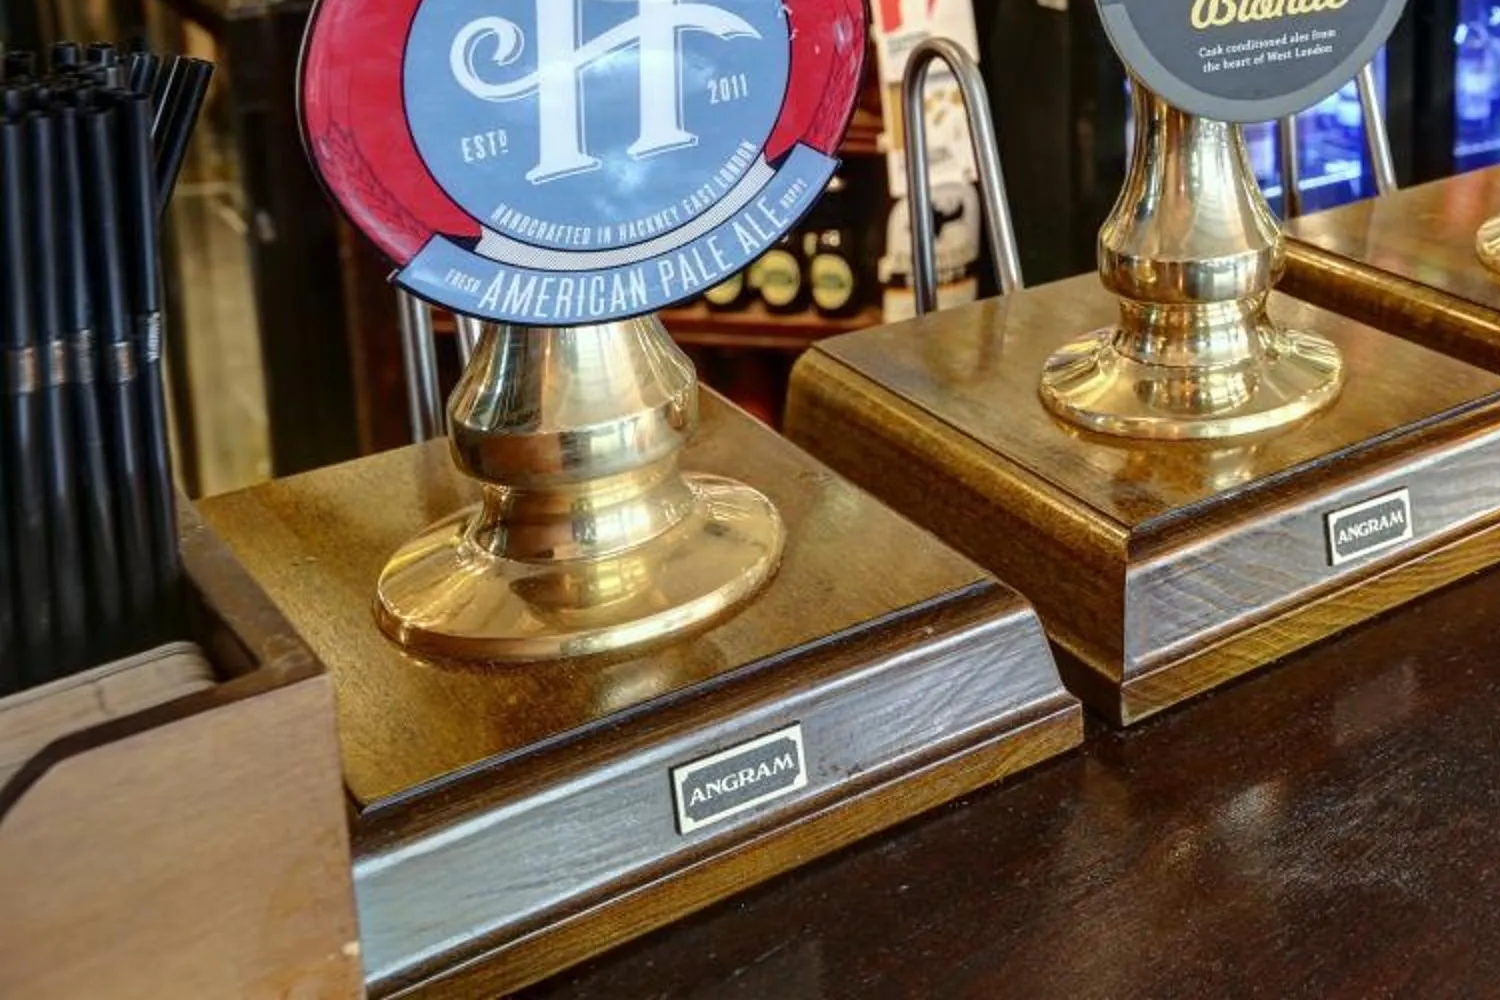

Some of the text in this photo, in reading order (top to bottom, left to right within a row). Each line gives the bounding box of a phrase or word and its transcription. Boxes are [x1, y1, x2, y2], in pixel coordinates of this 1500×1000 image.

[1198, 43, 1223, 58] Cask
[1225, 32, 1288, 53] conditioned
[1202, 43, 1333, 73] the heart of West London
[707, 72, 749, 104] 2011
[490, 141, 757, 246] HANDCRAFTED IN HACKNEY EAST LONDON
[478, 267, 648, 319] AMERICAN
[658, 236, 733, 298] PALE
[732, 194, 786, 255] ALE
[1337, 509, 1405, 545] ANGRAM
[689, 752, 795, 807] ANGRAM
